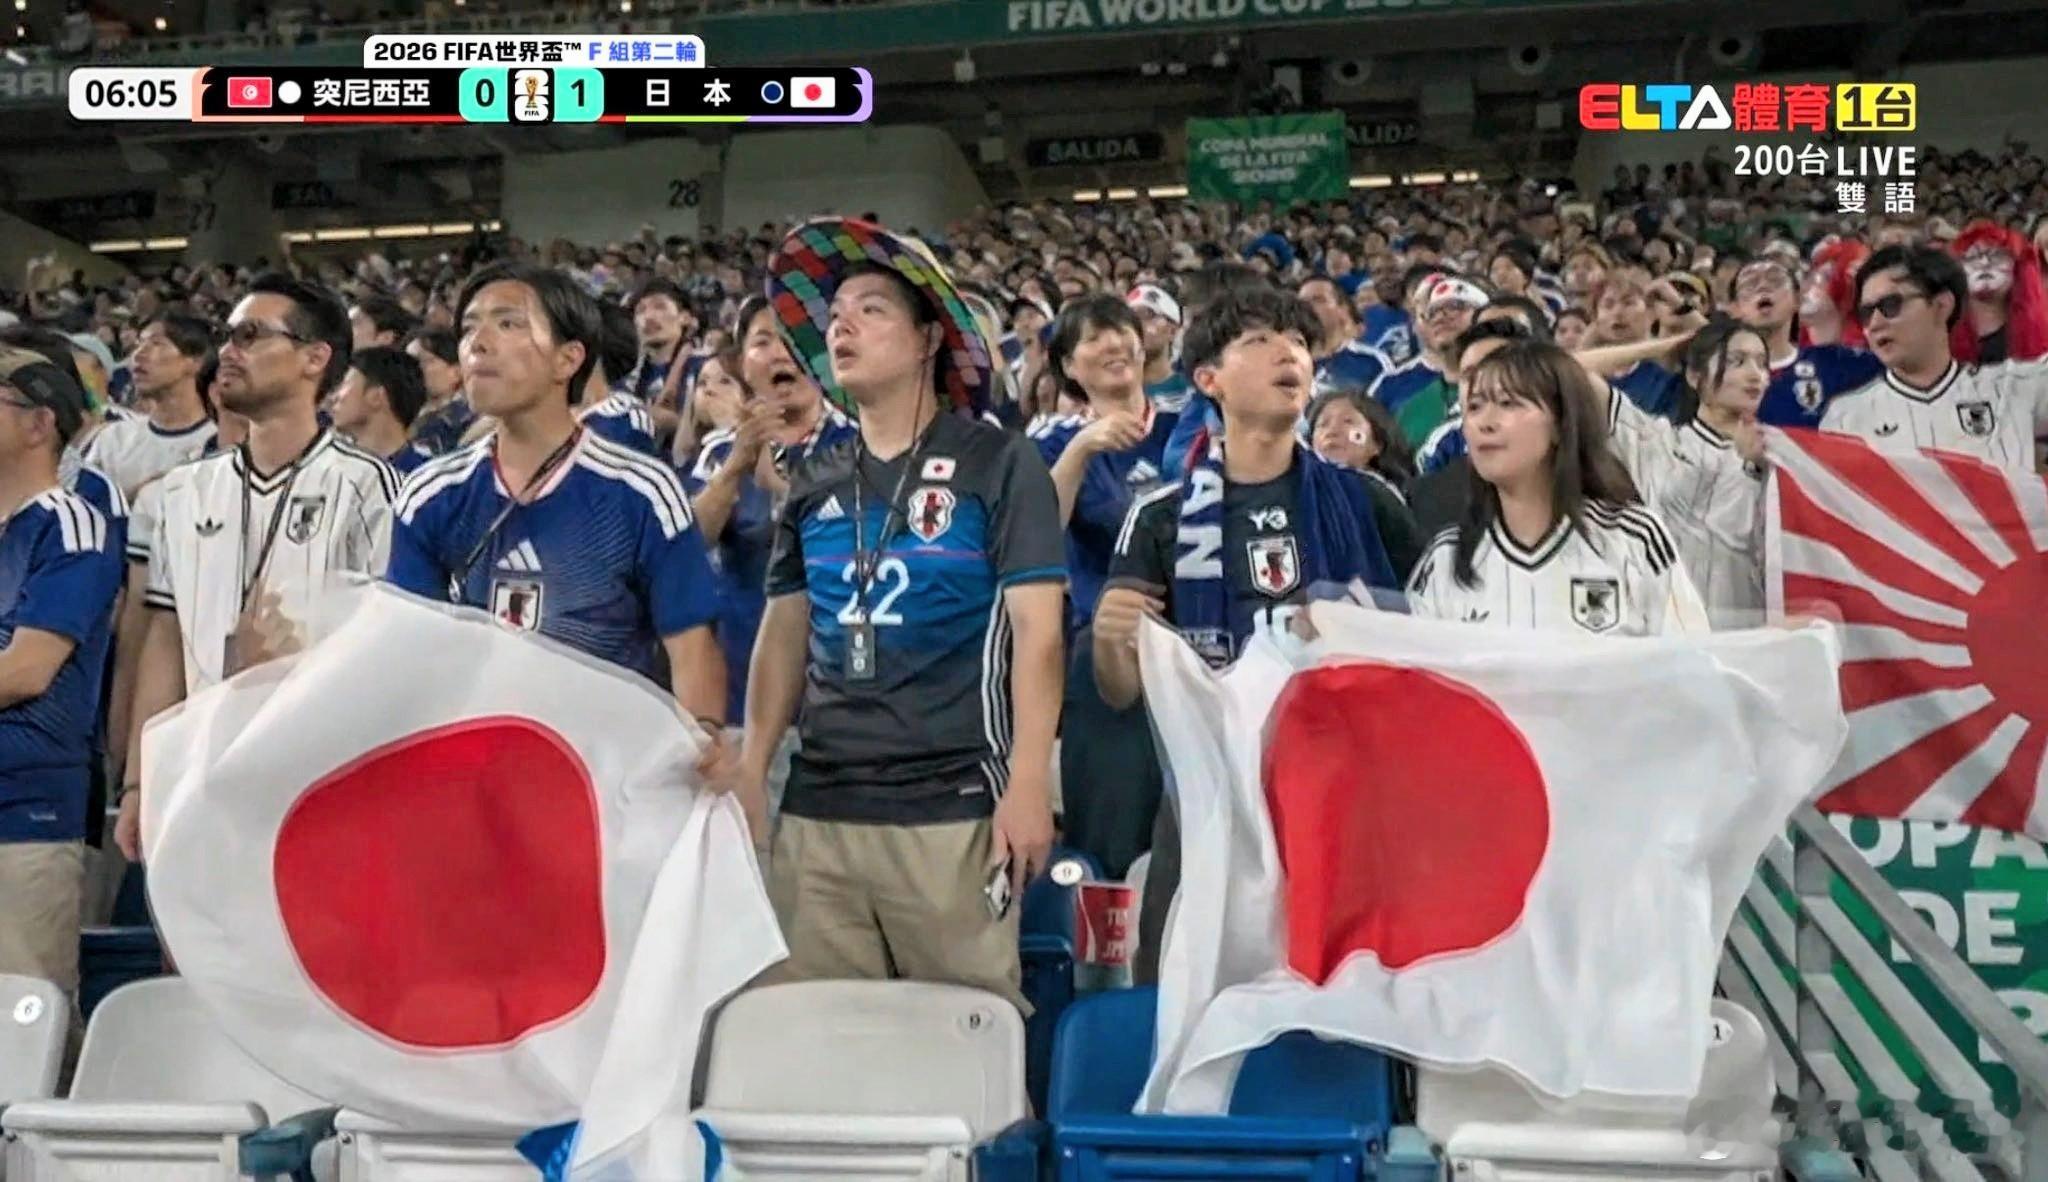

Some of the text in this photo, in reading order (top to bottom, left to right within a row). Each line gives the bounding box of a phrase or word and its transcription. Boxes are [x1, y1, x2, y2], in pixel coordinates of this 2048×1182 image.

[1008, 2, 1093, 31] FIFA
[1099, 0, 1246, 25] WORLD
[1347, 122, 1416, 145] ALIDA
[669, 179, 700, 208] 28
[1174, 467, 1225, 580] AN
[837, 557, 911, 625] 22
[1828, 811, 2048, 869] OPA
[1891, 889, 2025, 963] DE
